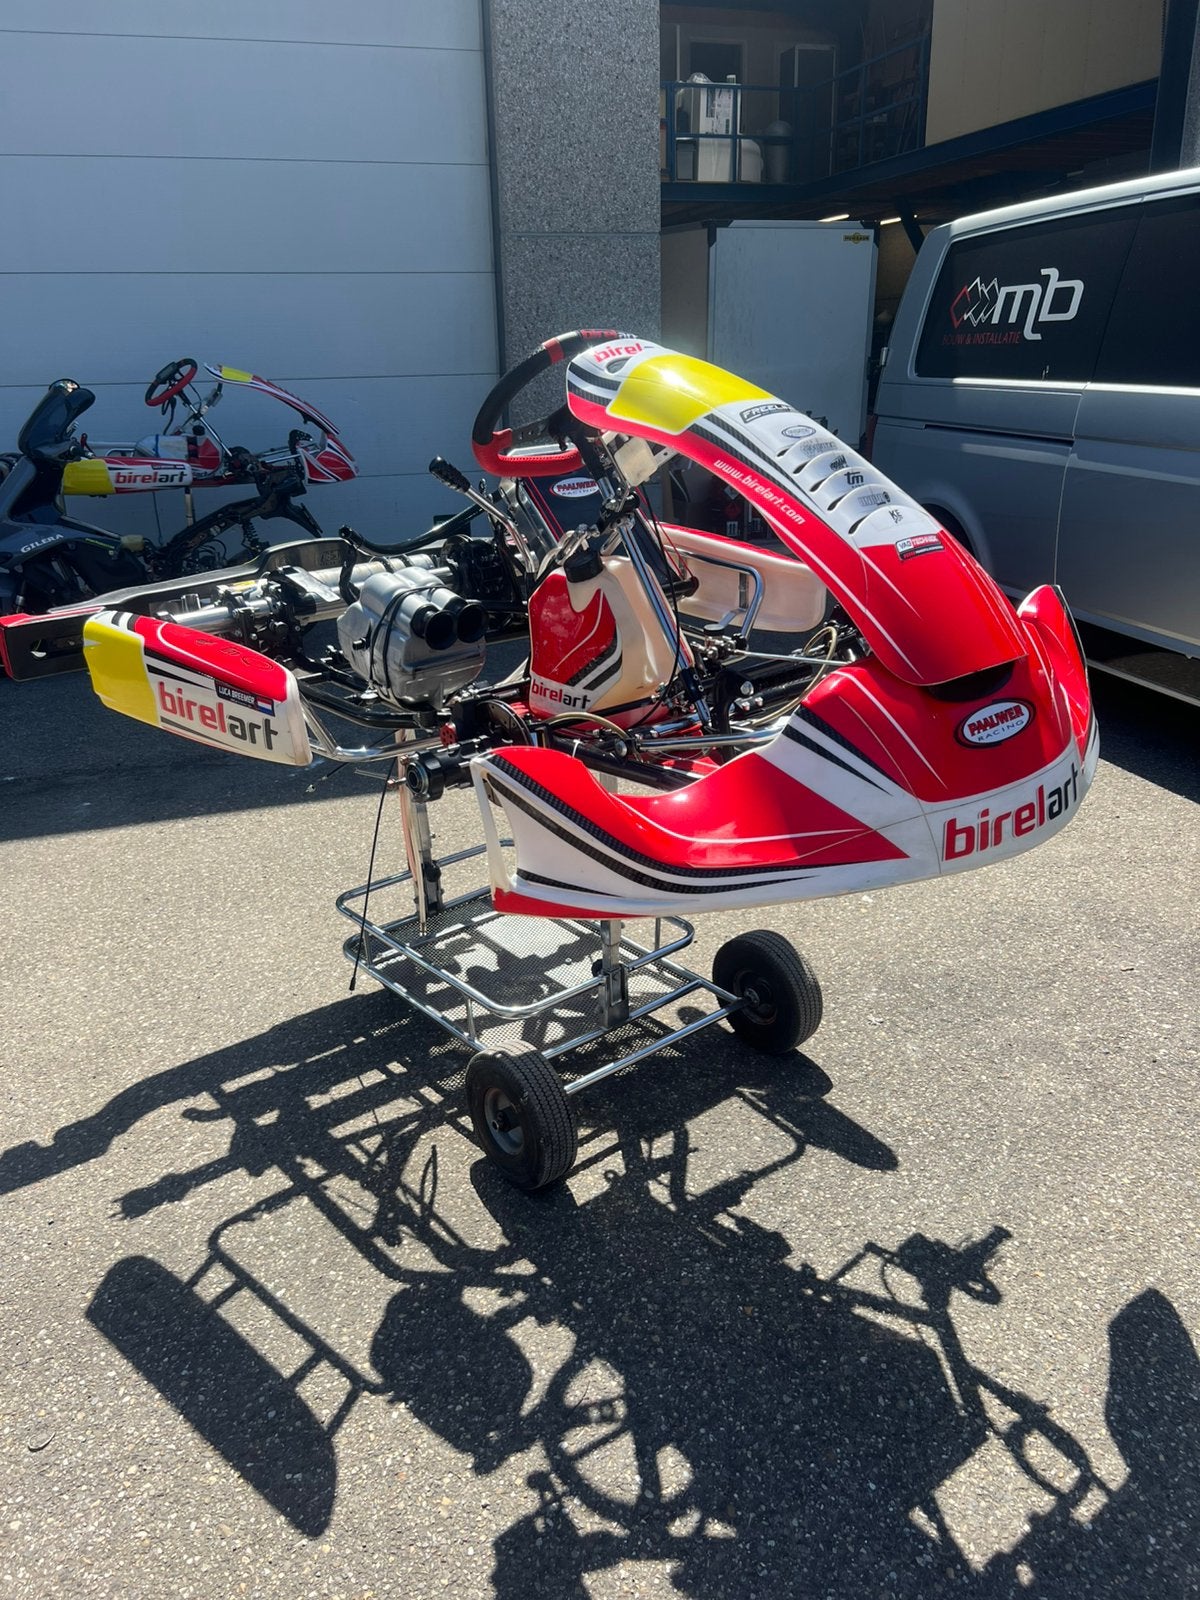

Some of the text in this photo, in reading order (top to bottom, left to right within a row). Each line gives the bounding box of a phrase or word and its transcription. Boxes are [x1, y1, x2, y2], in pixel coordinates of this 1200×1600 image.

[973, 331, 1020, 344] INSTALLATIE
[115, 471, 187, 484] birelart
[713, 459, 806, 525] www.birelart.com
[20, 533, 64, 553] GILERA
[218, 686, 231, 696] LUCA
[531, 679, 591, 709] birelart
[158, 681, 278, 750] birelart
[967, 704, 1025, 737] PAAUWER
[977, 719, 1024, 741] RACING
[942, 762, 1078, 861] birelart
